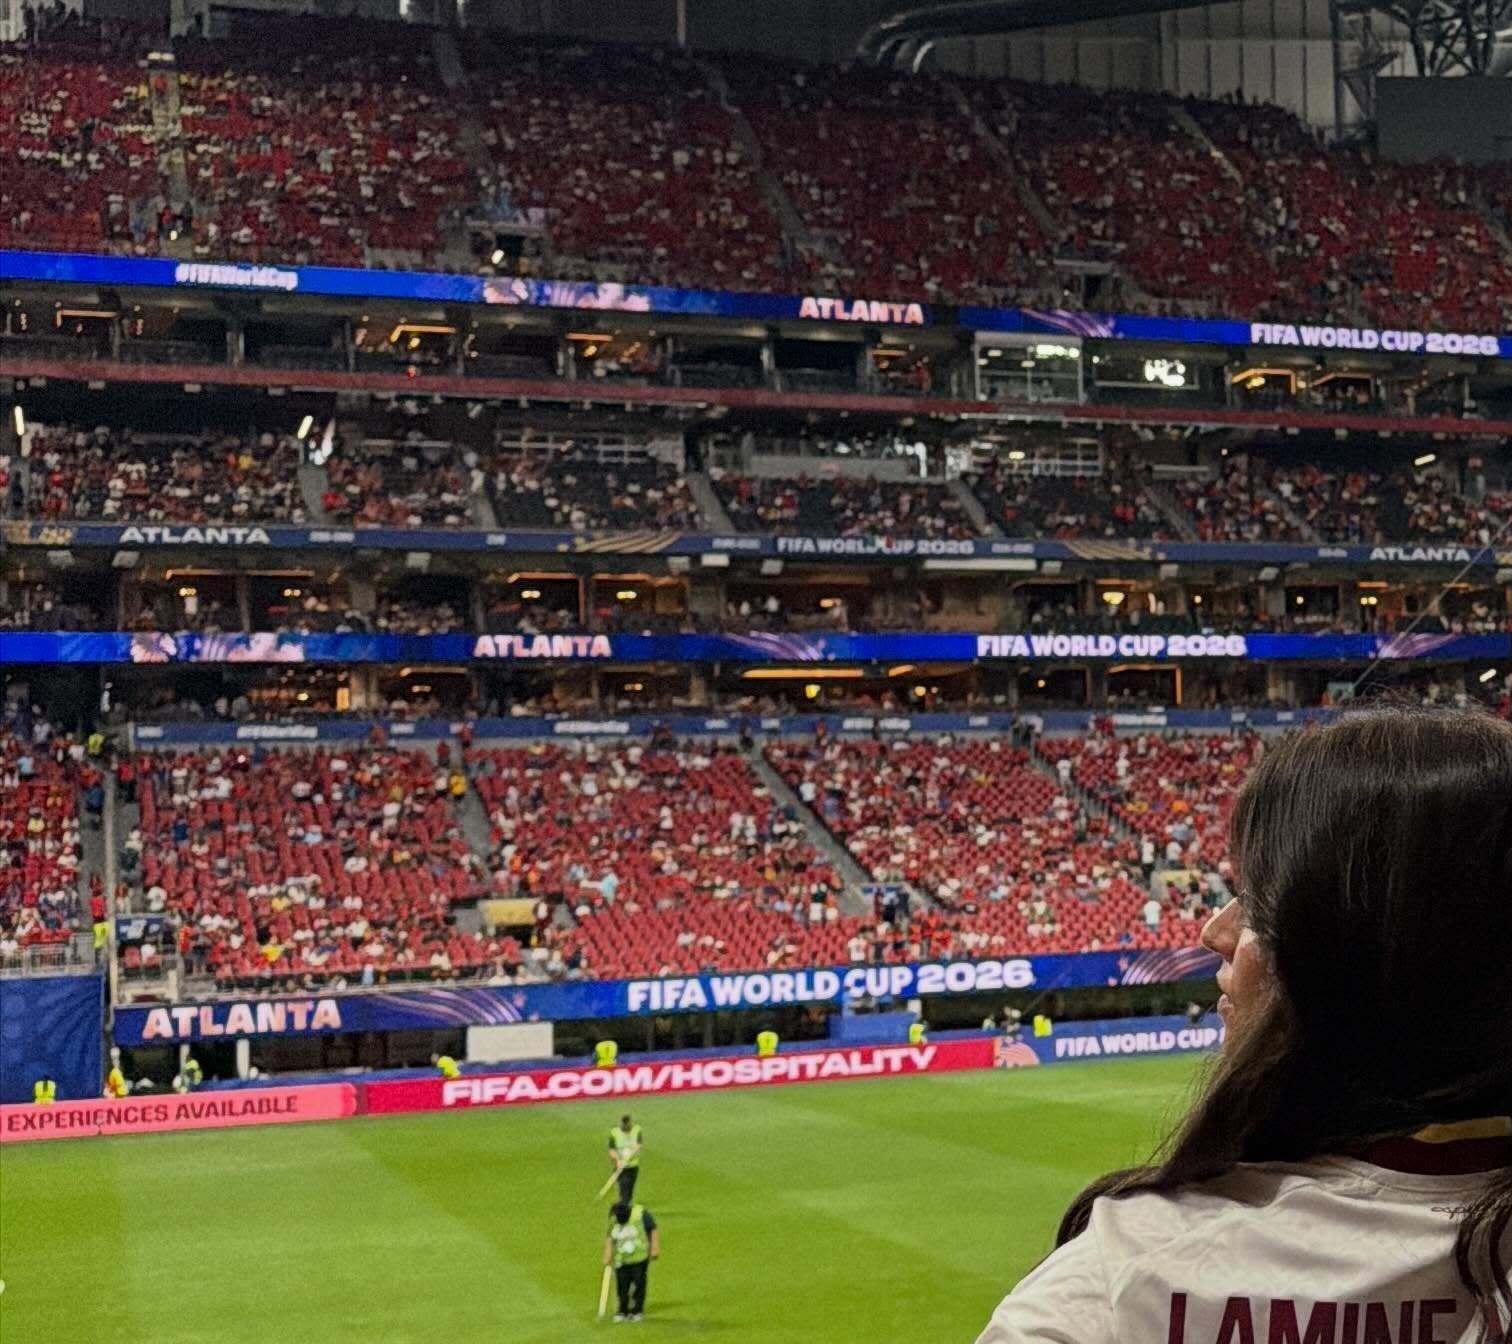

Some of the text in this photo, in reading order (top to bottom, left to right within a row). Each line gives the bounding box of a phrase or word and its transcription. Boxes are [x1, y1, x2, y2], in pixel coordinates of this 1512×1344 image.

[799, 296, 924, 325] ATLANTA
[1250, 322, 1500, 356] FIFA WORLD CUP 2026
[119, 526, 271, 545] ATLANTA
[777, 537, 814, 553] FIFA
[917, 540, 974, 555] 2026
[1369, 546, 1471, 562] ATLANTA
[473, 634, 612, 658] ATLANTA
[976, 634, 1248, 657] FIFA WORLD CUP 2026
[627, 959, 1033, 1013] FIFA WORLD CUP 2026
[142, 998, 341, 1040] ATLANTA
[1055, 1036, 1101, 1058] FIFA
[1102, 1031, 1176, 1054] WORLD
[1177, 1028, 1218, 1049] CUP
[442, 1045, 937, 1107] FIFA.COM/HOSPITALITY
[8, 1095, 299, 1133] EXPERIENCES AVAILABLE
